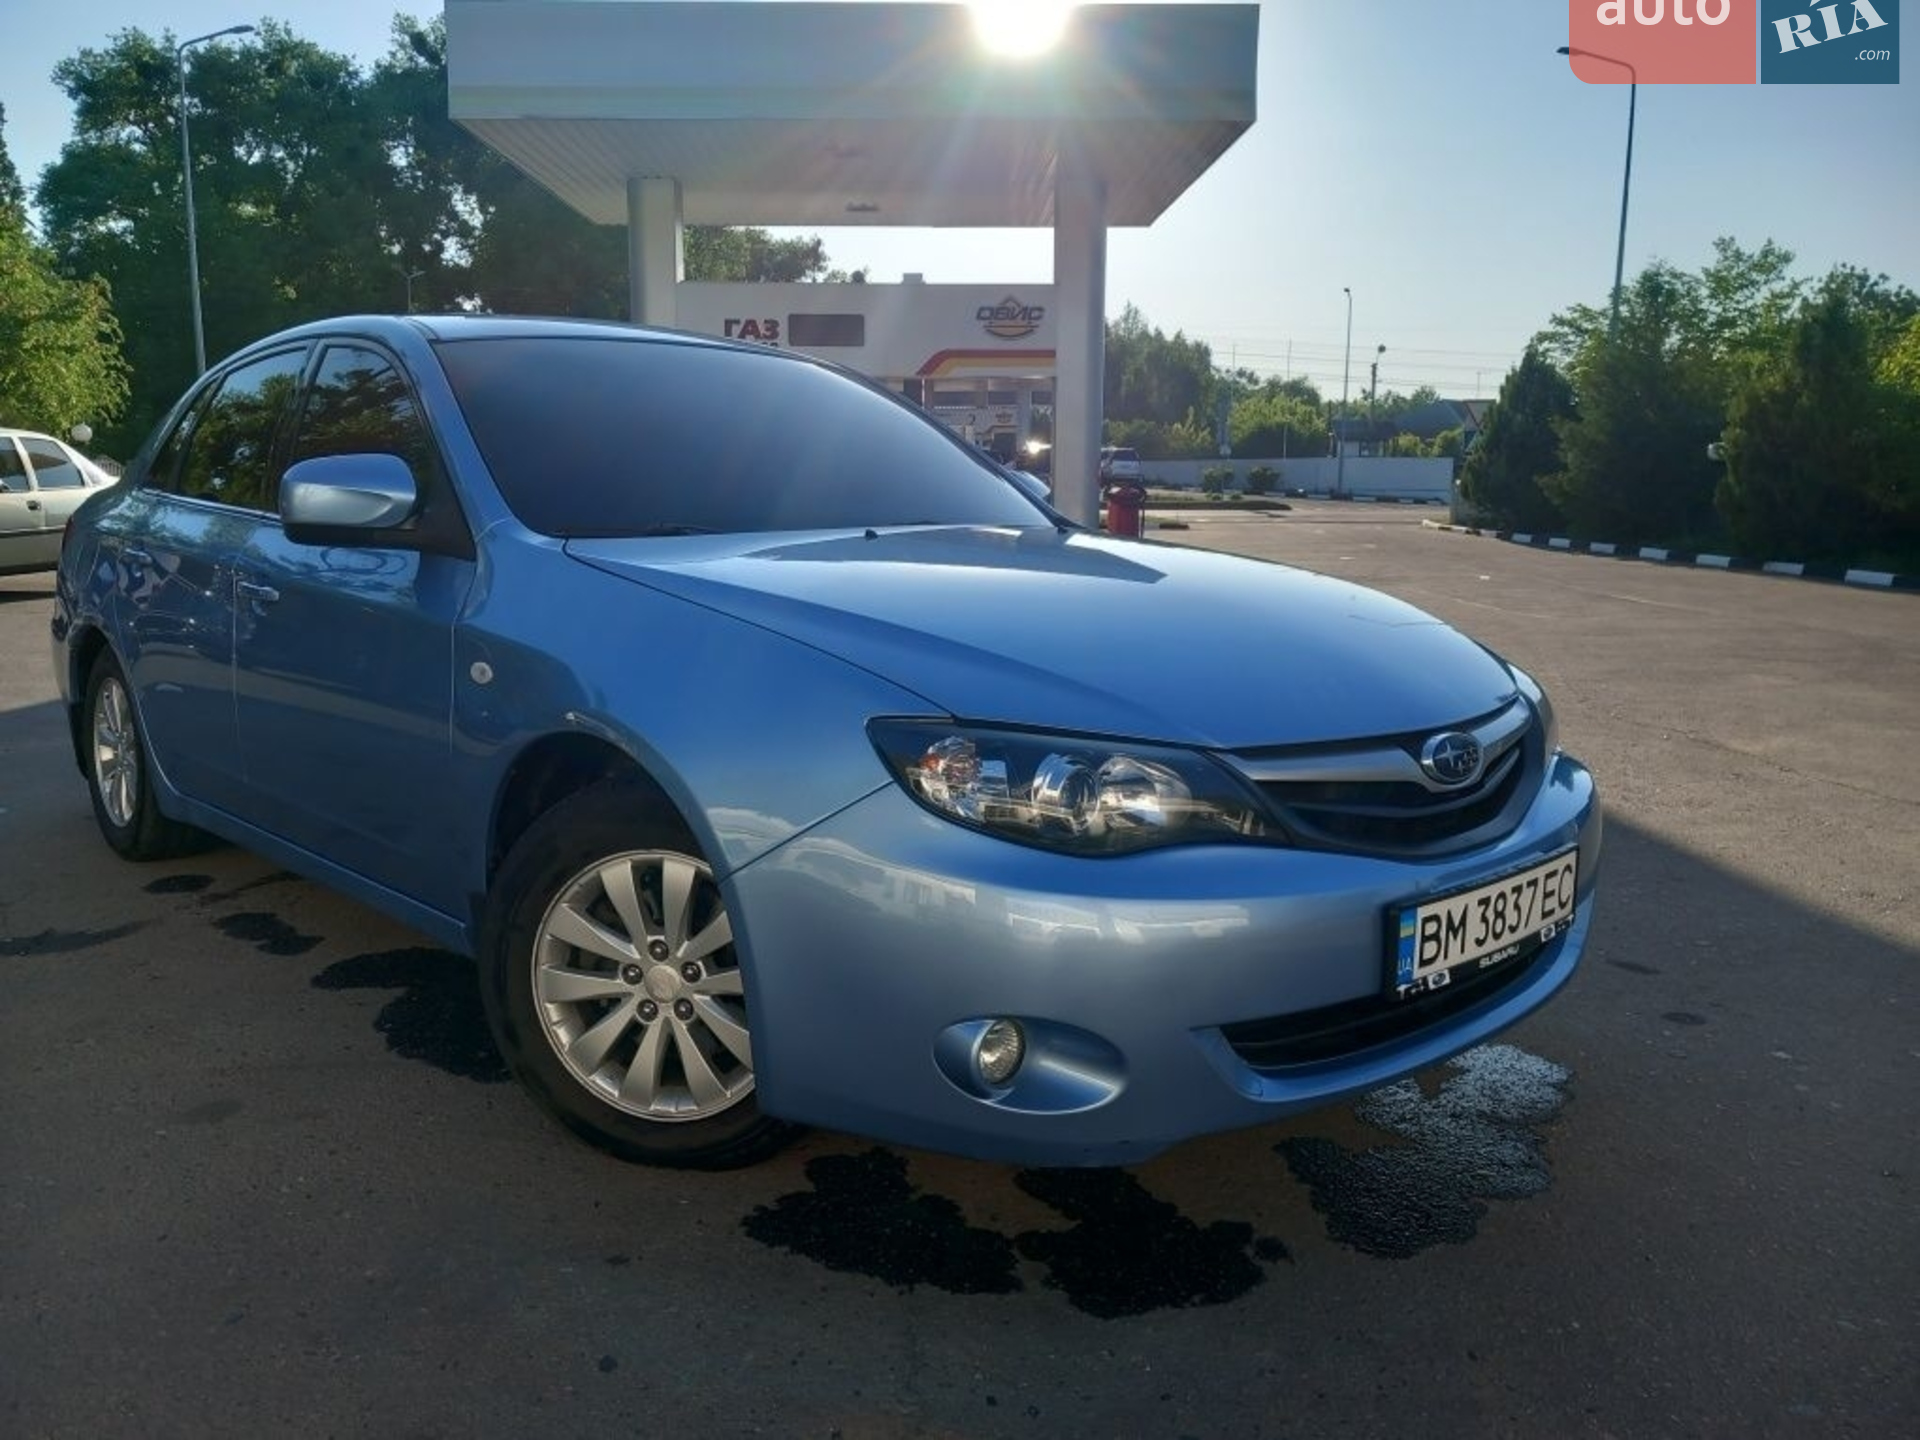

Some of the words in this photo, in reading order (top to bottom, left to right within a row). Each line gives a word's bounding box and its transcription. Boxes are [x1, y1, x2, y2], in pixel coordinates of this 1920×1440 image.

[724, 318, 780, 339] ГАЗ
[1419, 903, 1469, 967] BM
[1474, 876, 1539, 947] 3837
[1541, 863, 1573, 920] EC
